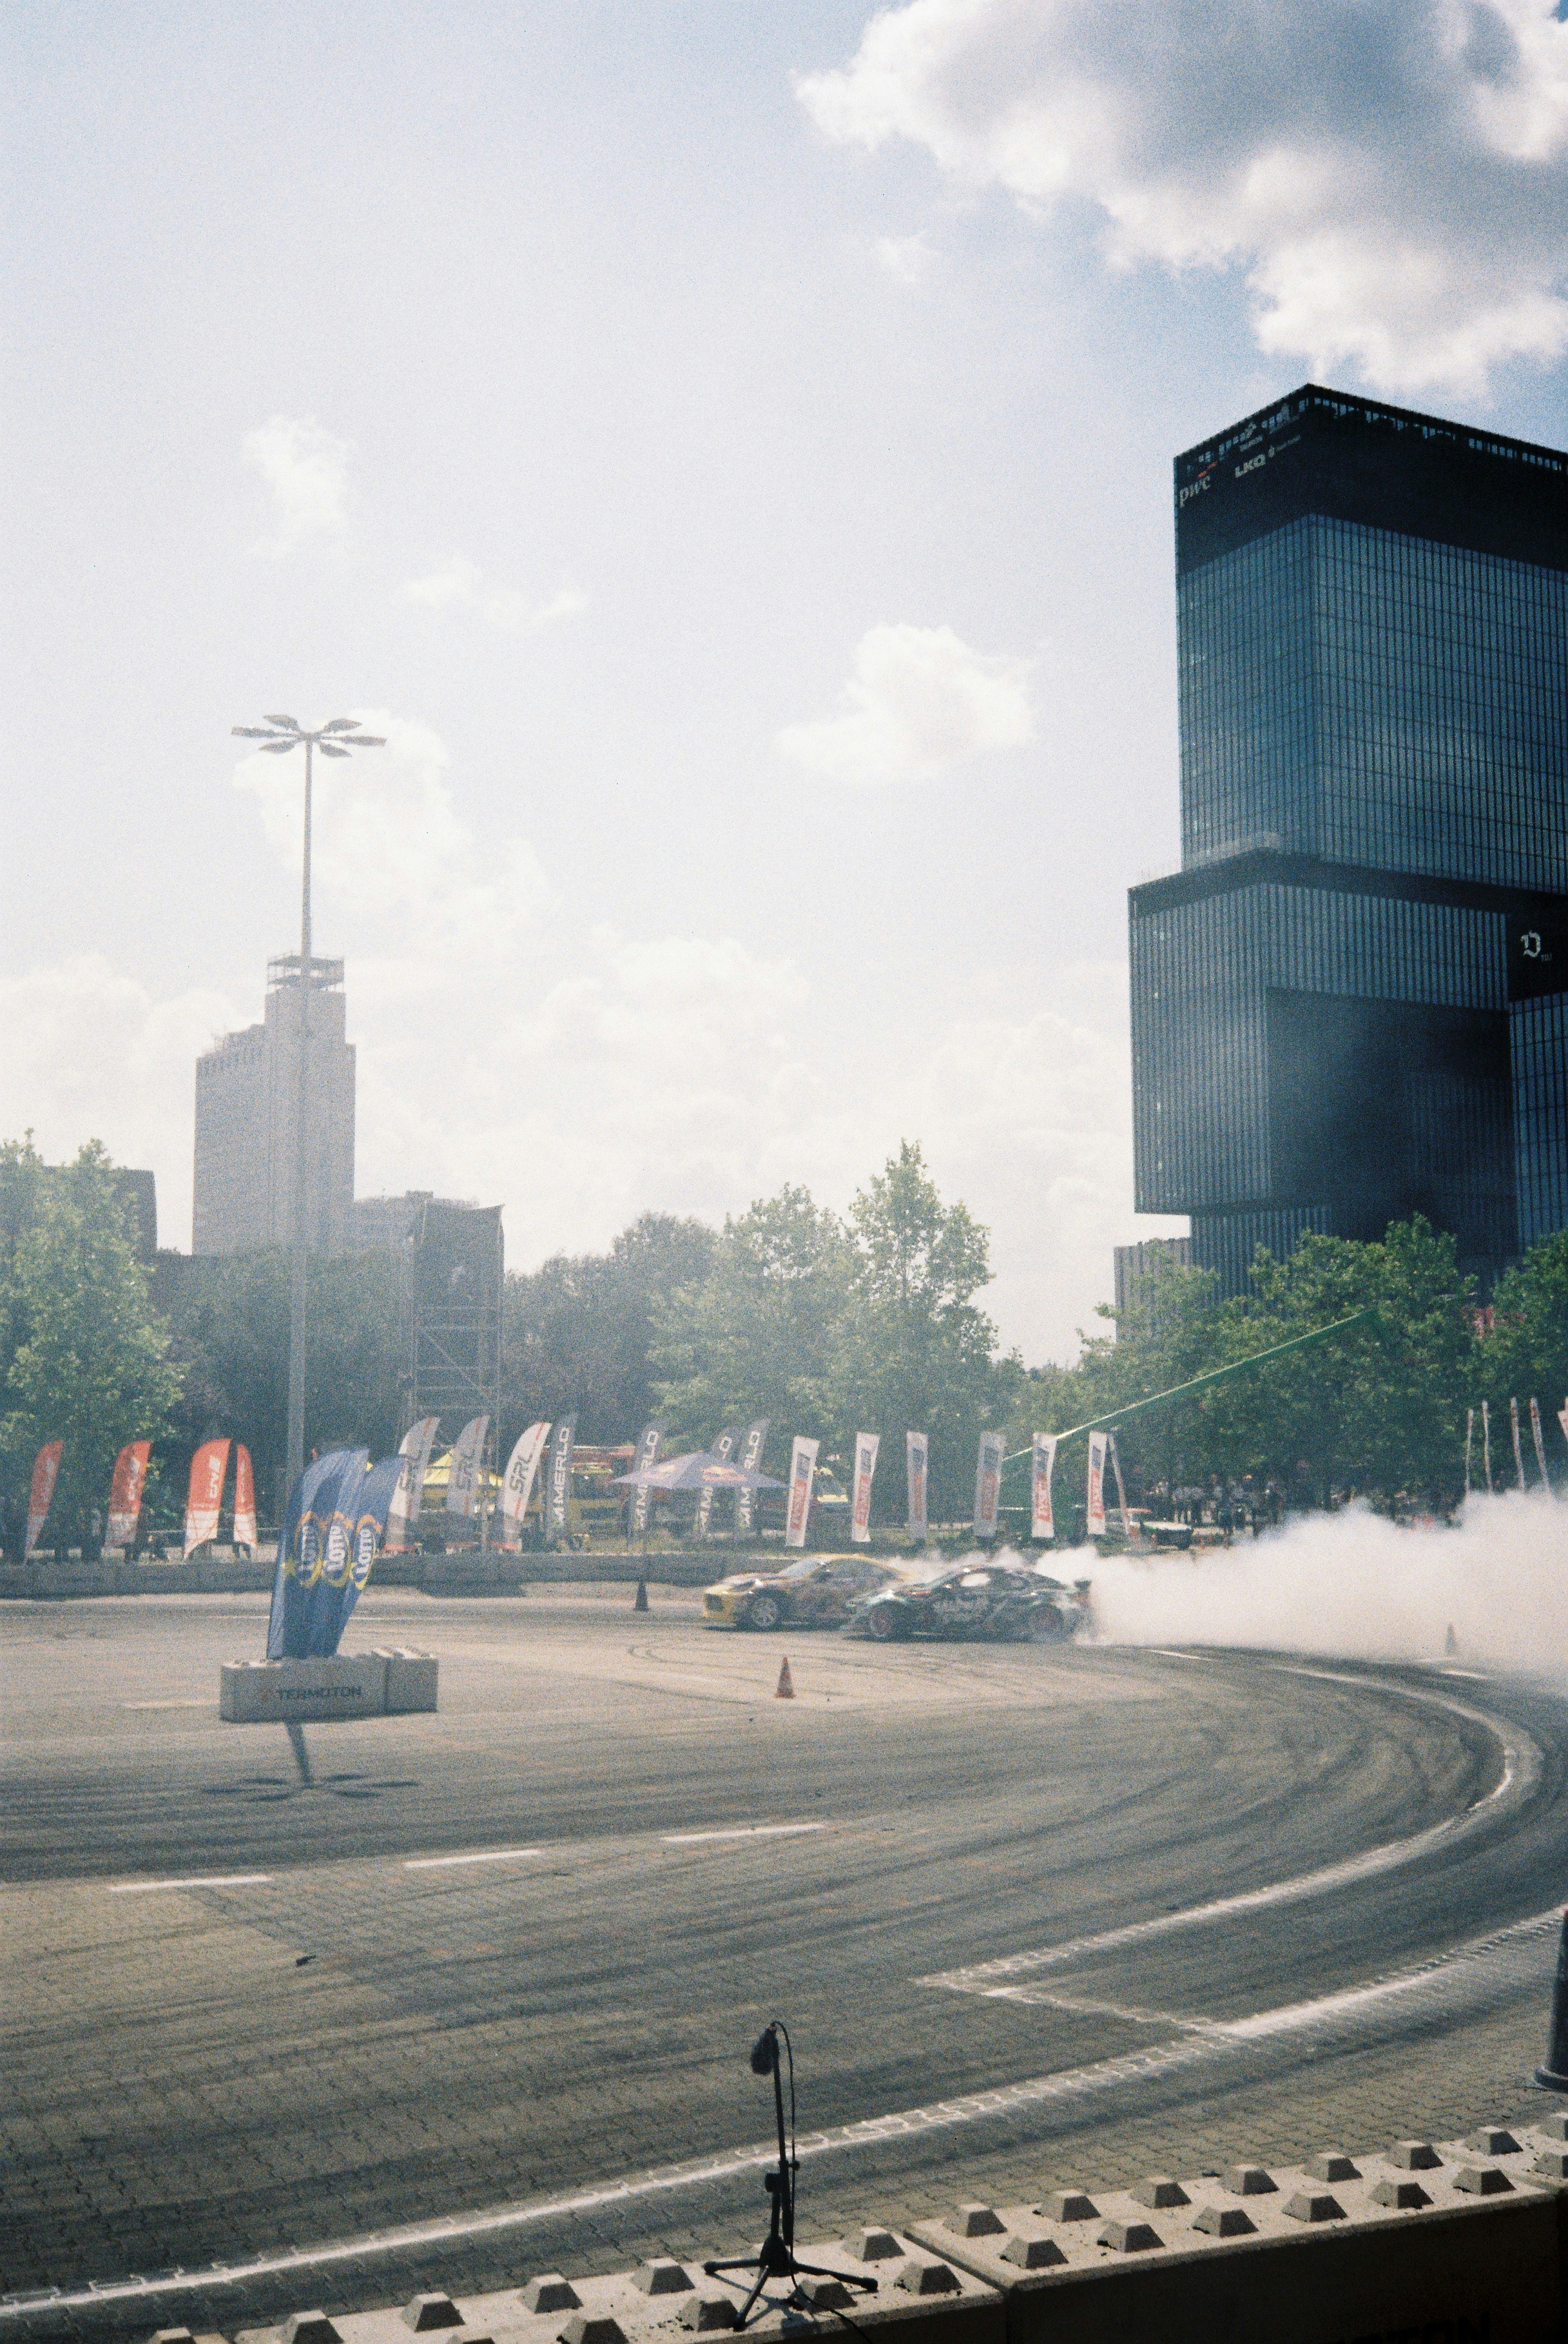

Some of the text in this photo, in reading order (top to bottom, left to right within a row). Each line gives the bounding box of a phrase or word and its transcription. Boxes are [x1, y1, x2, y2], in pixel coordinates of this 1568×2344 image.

[1235, 454, 1266, 478] LKQ
[1179, 476, 1210, 508] pwc
[509, 1451, 534, 1494] SRL
[554, 1427, 570, 1504] MERLO
[740, 1431, 760, 1505] MRLO
[326, 1525, 345, 1571] LOTTO
[356, 1528, 373, 1574] LOTTO
